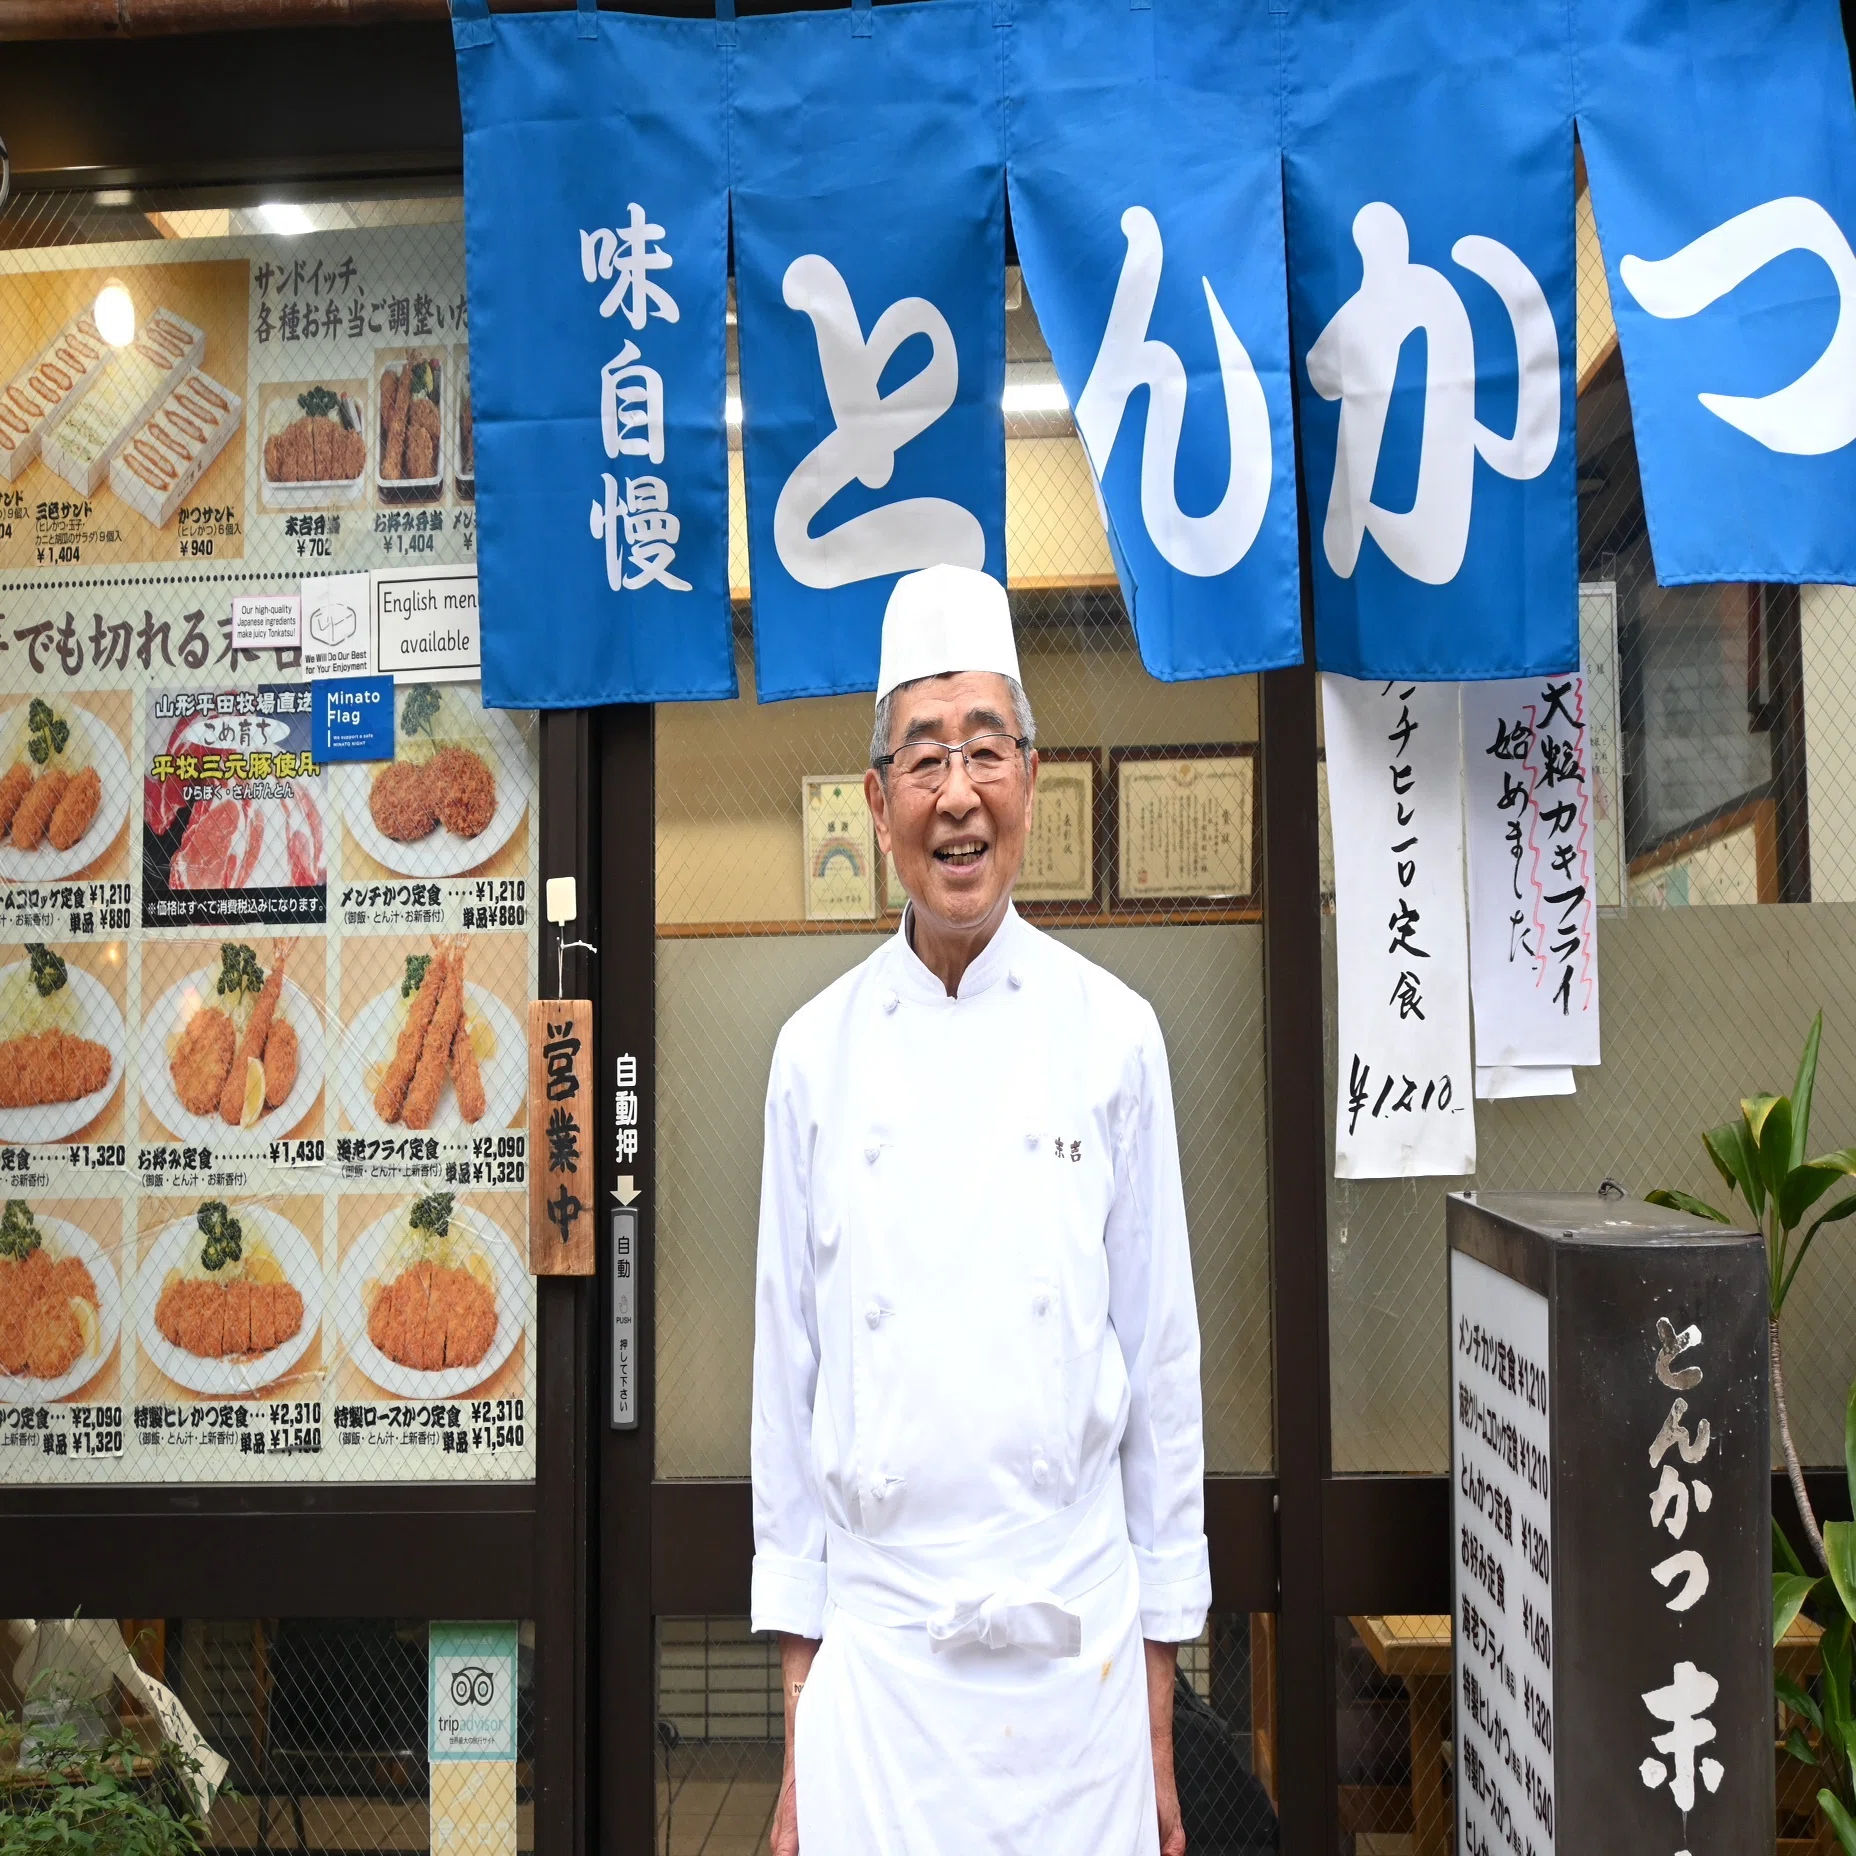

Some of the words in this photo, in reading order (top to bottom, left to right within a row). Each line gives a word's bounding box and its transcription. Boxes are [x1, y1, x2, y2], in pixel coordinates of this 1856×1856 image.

[579, 202, 693, 593] 味自慢
[773, 195, 1856, 590] とんかつ
[0, 490, 23, 507] ンド
[178, 505, 235, 524] かつサンド
[374, 509, 443, 533] お好み弁当
[37, 546, 80, 564] ¥1,404
[180, 539, 213, 556] ¥940
[297, 538, 332, 557] ¥702
[384, 533, 434, 555] ¥1,404
[241, 605, 254, 615] Our
[255, 604, 293, 615] high-quality
[383, 588, 438, 620] English
[237, 616, 264, 627] Japanese
[265, 616, 296, 627] ingredients
[237, 630, 252, 638] make
[253, 628, 267, 639] juicy
[268, 628, 296, 638] Tonkatsu!
[400, 629, 470, 654] available
[305, 653, 315, 663] We
[316, 653, 327, 663] Will
[328, 652, 337, 662] Do
[338, 651, 350, 661] Our
[351, 650, 367, 661] Best
[305, 665, 315, 675] for
[316, 663, 331, 674] Your
[333, 661, 367, 674] Enjoyment
[328, 690, 380, 705] Minato
[328, 709, 360, 726] Flag
[204, 719, 271, 747] こめ育ち
[151, 751, 321, 781] 平牧三元豚使用
[1536, 681, 1586, 1017] 大粒カキフライ
[90, 884, 131, 907] ¥1,210
[340, 884, 441, 907] メンチかつ定食
[476, 880, 525, 904] ¥1,210
[69, 911, 94, 934] 単品
[100, 908, 131, 929] ¥880
[463, 907, 488, 930] 単品
[488, 905, 525, 927] ¥880
[615, 1052, 638, 1163] 自動押
[543, 1020, 582, 1245] 営業中
[70, 1145, 126, 1170] ¥1,320
[138, 1147, 213, 1171] お好み定食
[269, 1140, 325, 1165] ¥1,430
[336, 1137, 440, 1161] 海老フライ定食
[473, 1137, 525, 1161] ¥2,090
[445, 1162, 470, 1186] 単品
[473, 1161, 525, 1187] ¥1,320
[617, 1236, 630, 1279] 自動
[619, 1339, 628, 1412] 押して下さい
[1458, 1314, 1516, 1395] メンチカツ定食
[1518, 1352, 1547, 1416] ¥1,210
[72, 1406, 122, 1431] ¥2,090
[134, 1405, 248, 1429] 特製ヒレかつ定食
[270, 1402, 321, 1427] ¥2,310
[334, 1405, 461, 1429] 特製ロースかつ定食
[471, 1400, 524, 1425] ¥2,310
[43, 1432, 67, 1456] 単品
[72, 1430, 122, 1456] ¥1,320
[240, 1432, 265, 1455] 単品
[443, 1431, 468, 1454] 単品
[472, 1425, 524, 1450] ¥1,540
[1520, 1433, 1548, 1500] ¥1,210
[1648, 1316, 1712, 1613] とんかつ
[1461, 1452, 1513, 1547] とんかつ定食
[1521, 1513, 1549, 1581] ¥1,320
[1461, 1523, 1506, 1614] お好み定食
[1522, 1593, 1550, 1670] ¥1,430
[1462, 1591, 1504, 1684] 海老フライ
[1524, 1674, 1551, 1755] ¥1,320
[438, 1715, 502, 1735] tripadvisor
[1463, 1663, 1511, 1766] 特製ヒレかつ
[1525, 1755, 1553, 1840] ¥1,540
[1464, 1733, 1512, 1844] 特製ロースかつ
